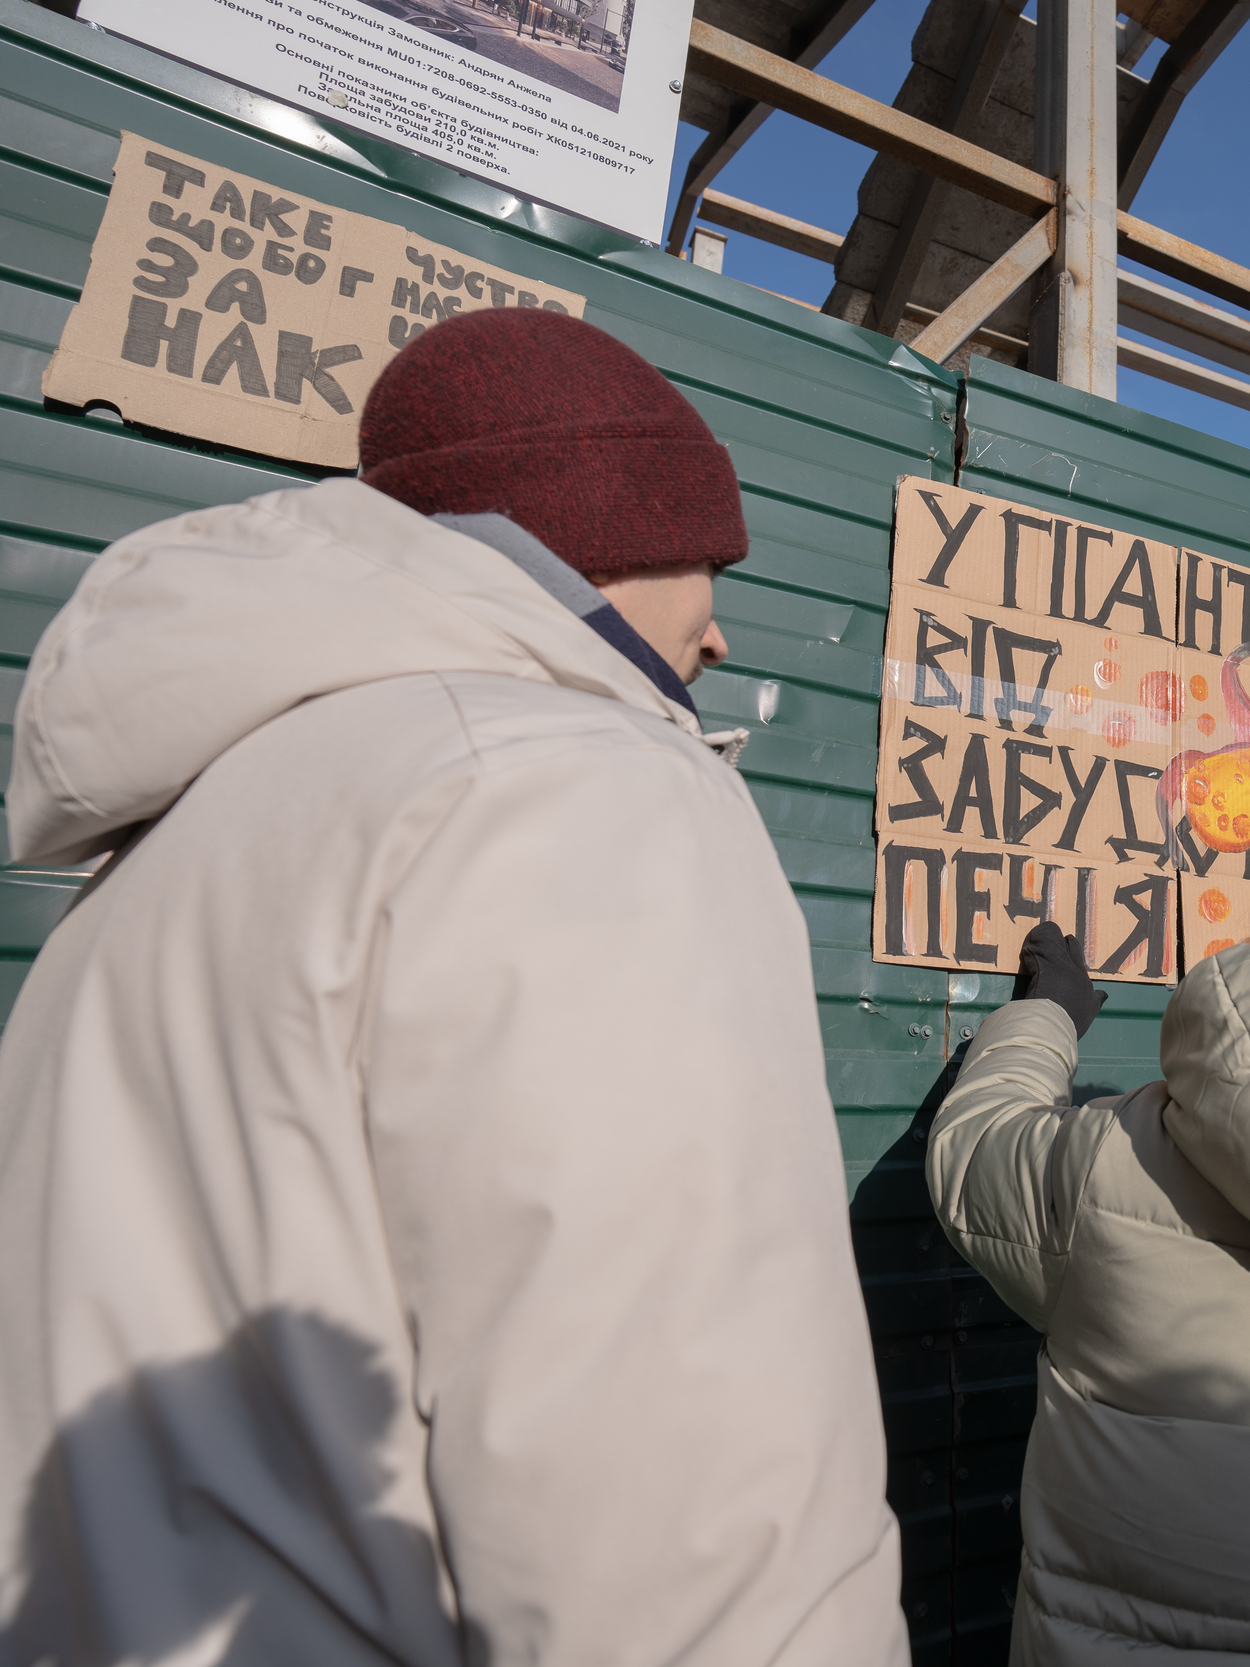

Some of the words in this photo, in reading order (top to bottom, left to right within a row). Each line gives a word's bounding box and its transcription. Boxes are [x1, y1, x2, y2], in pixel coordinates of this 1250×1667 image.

[267, 19, 294, 35] про
[298, 31, 355, 61] початок
[358, 57, 428, 91] виконання
[431, 86, 509, 125] будівельних
[512, 121, 544, 138] робіт
[275, 42, 334, 73] Основні
[337, 70, 407, 103] показники
[410, 100, 457, 123] об'єкта
[460, 119, 539, 157] будівництва:
[287, 5, 302, 17] та
[306, 14, 383, 52] обмеження
[387, 47, 548, 120] MU01:7208-0692-5553-0350
[550, 117, 568, 131] від
[571, 124, 626, 153] 04.06.2021
[629, 149, 654, 165] року
[313, 0, 384, 31] нструкція
[388, 27, 455, 62] Замовник:
[458, 58, 504, 83] Андрян
[507, 79, 552, 103] Анжела
[318, 82, 381, 114] Зльна
[385, 111, 428, 132] площа
[431, 128, 464, 146] 405,0
[467, 143, 497, 160] кв.м.
[319, 71, 366, 97] Площа
[369, 94, 431, 123] забудови
[434, 119, 467, 137] 210,0
[470, 134, 500, 151] кв.м.
[396, 124, 443, 148] будівлі
[446, 144, 454, 153] 2
[456, 149, 511, 175] поверха.
[144, 150, 333, 251] ТАКЕ
[132, 236, 267, 326] ЗА
[913, 489, 987, 589] У
[909, 607, 1063, 739] ВІД
[881, 839, 1176, 978] ПЕЧІЯ
